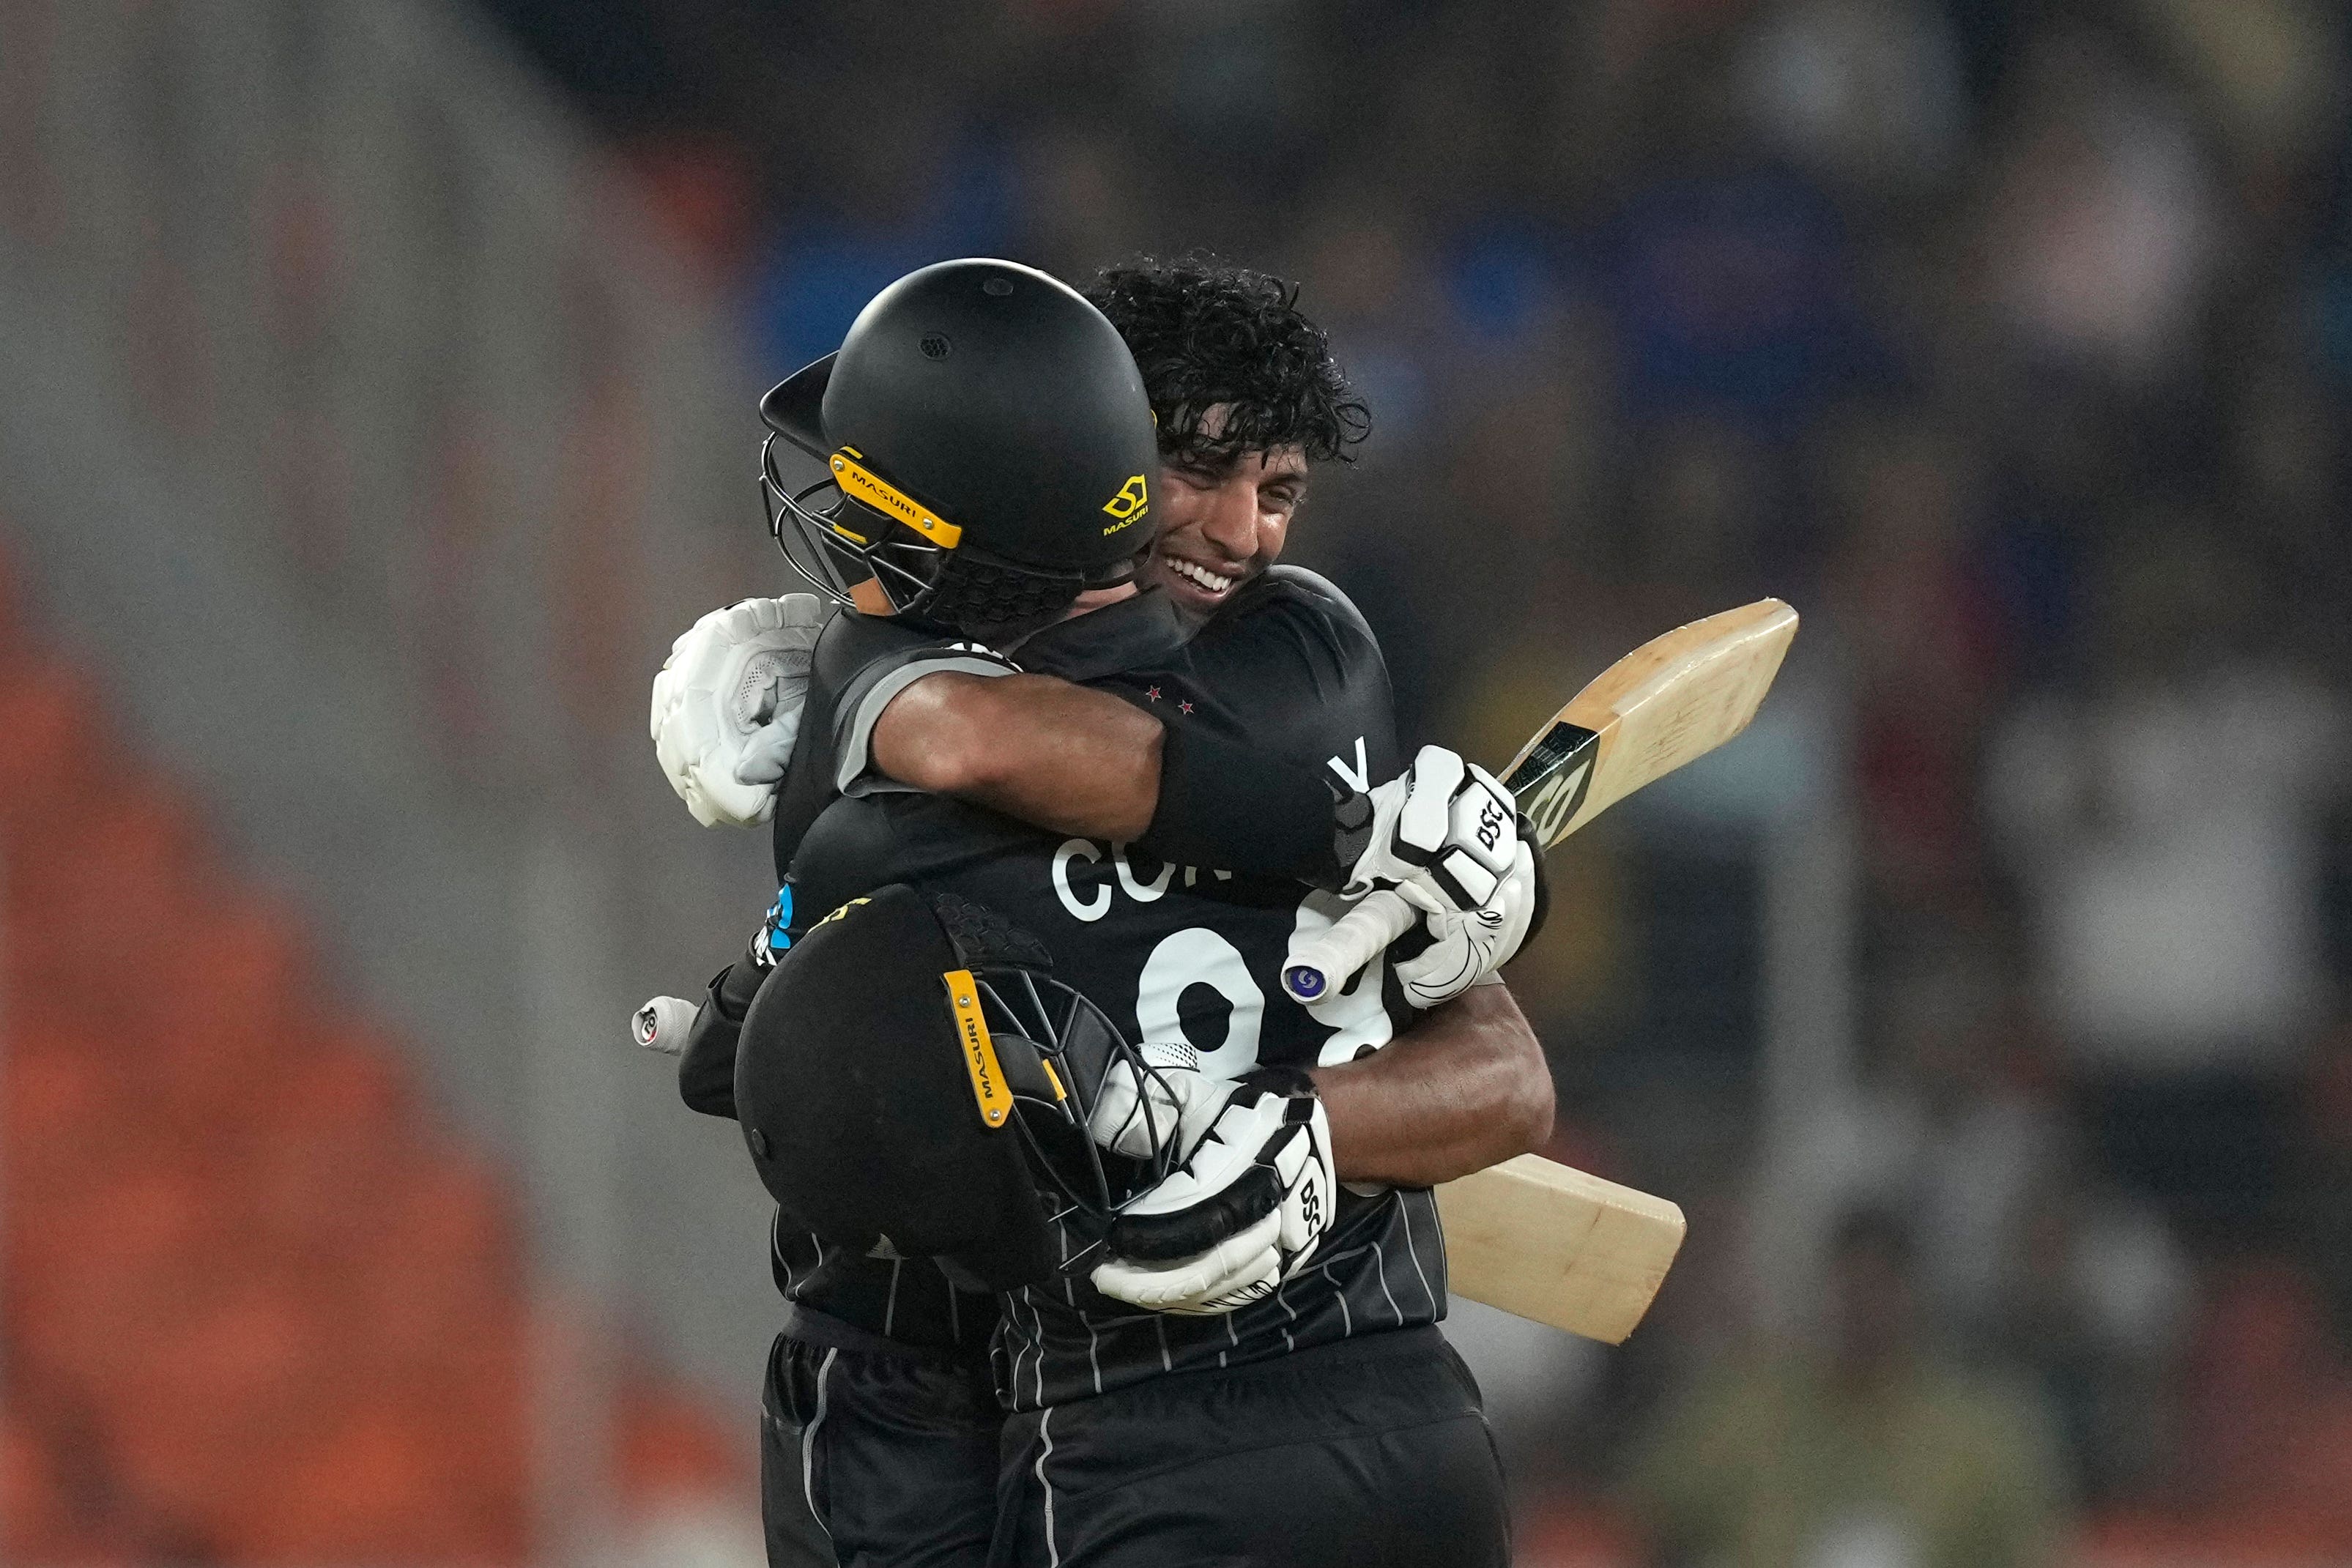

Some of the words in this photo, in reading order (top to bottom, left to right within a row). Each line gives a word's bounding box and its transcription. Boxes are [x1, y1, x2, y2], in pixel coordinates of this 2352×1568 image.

[852, 472, 916, 517] MASURI
[1103, 505, 1149, 536] MASURI
[1477, 800, 1503, 852] DSC
[965, 1017, 993, 1099] MASURI
[1301, 1177, 1320, 1237] DSC
